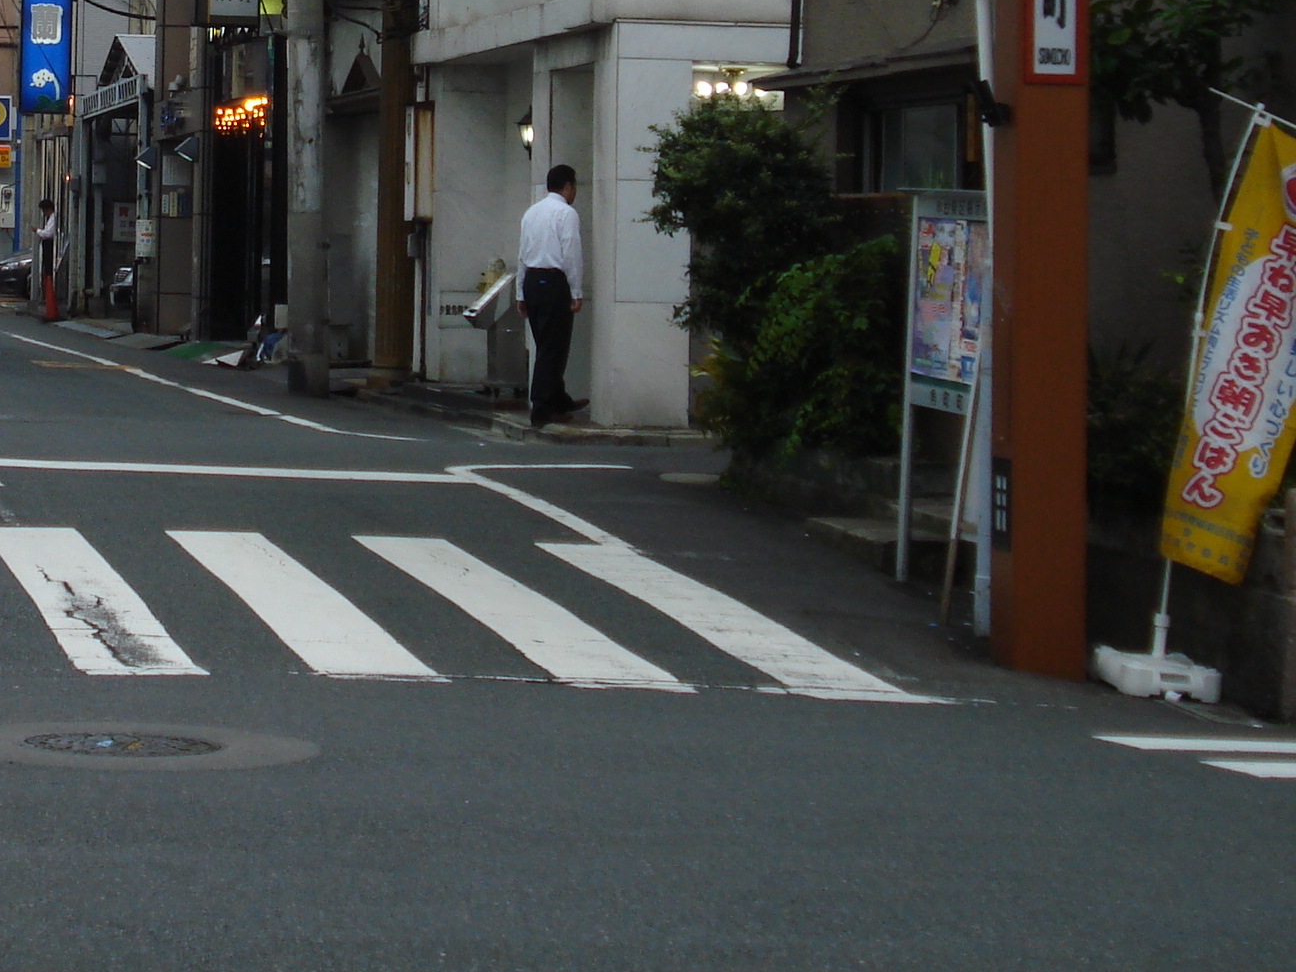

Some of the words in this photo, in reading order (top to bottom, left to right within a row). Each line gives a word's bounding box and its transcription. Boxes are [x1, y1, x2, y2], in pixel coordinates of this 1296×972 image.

[1252, 336, 1296, 477] しい心づくり
